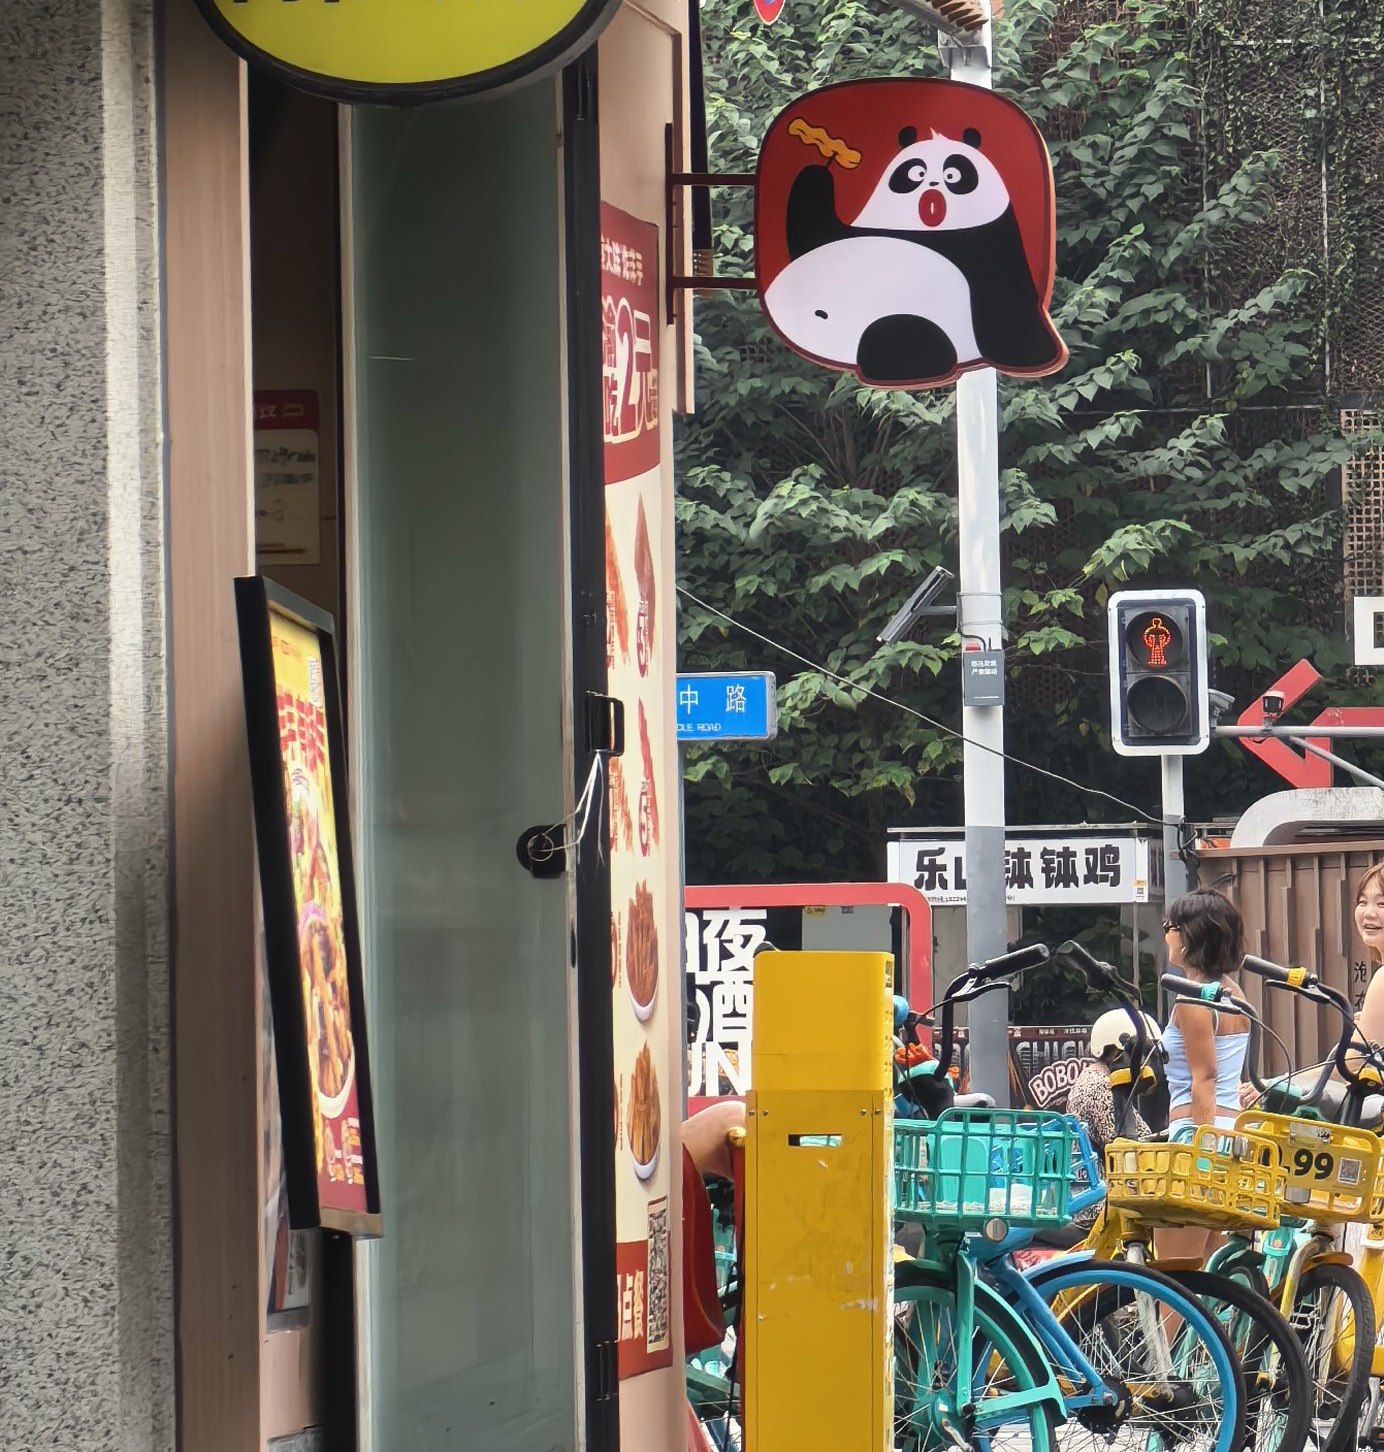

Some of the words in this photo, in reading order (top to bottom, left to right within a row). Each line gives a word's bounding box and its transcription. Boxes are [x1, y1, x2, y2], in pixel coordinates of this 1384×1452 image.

[679, 683, 747, 714] 中路
[697, 723, 721, 732] ROAD
[1032, 1059, 1091, 1102] BOBO
[618, 1269, 644, 1341] 点餐
